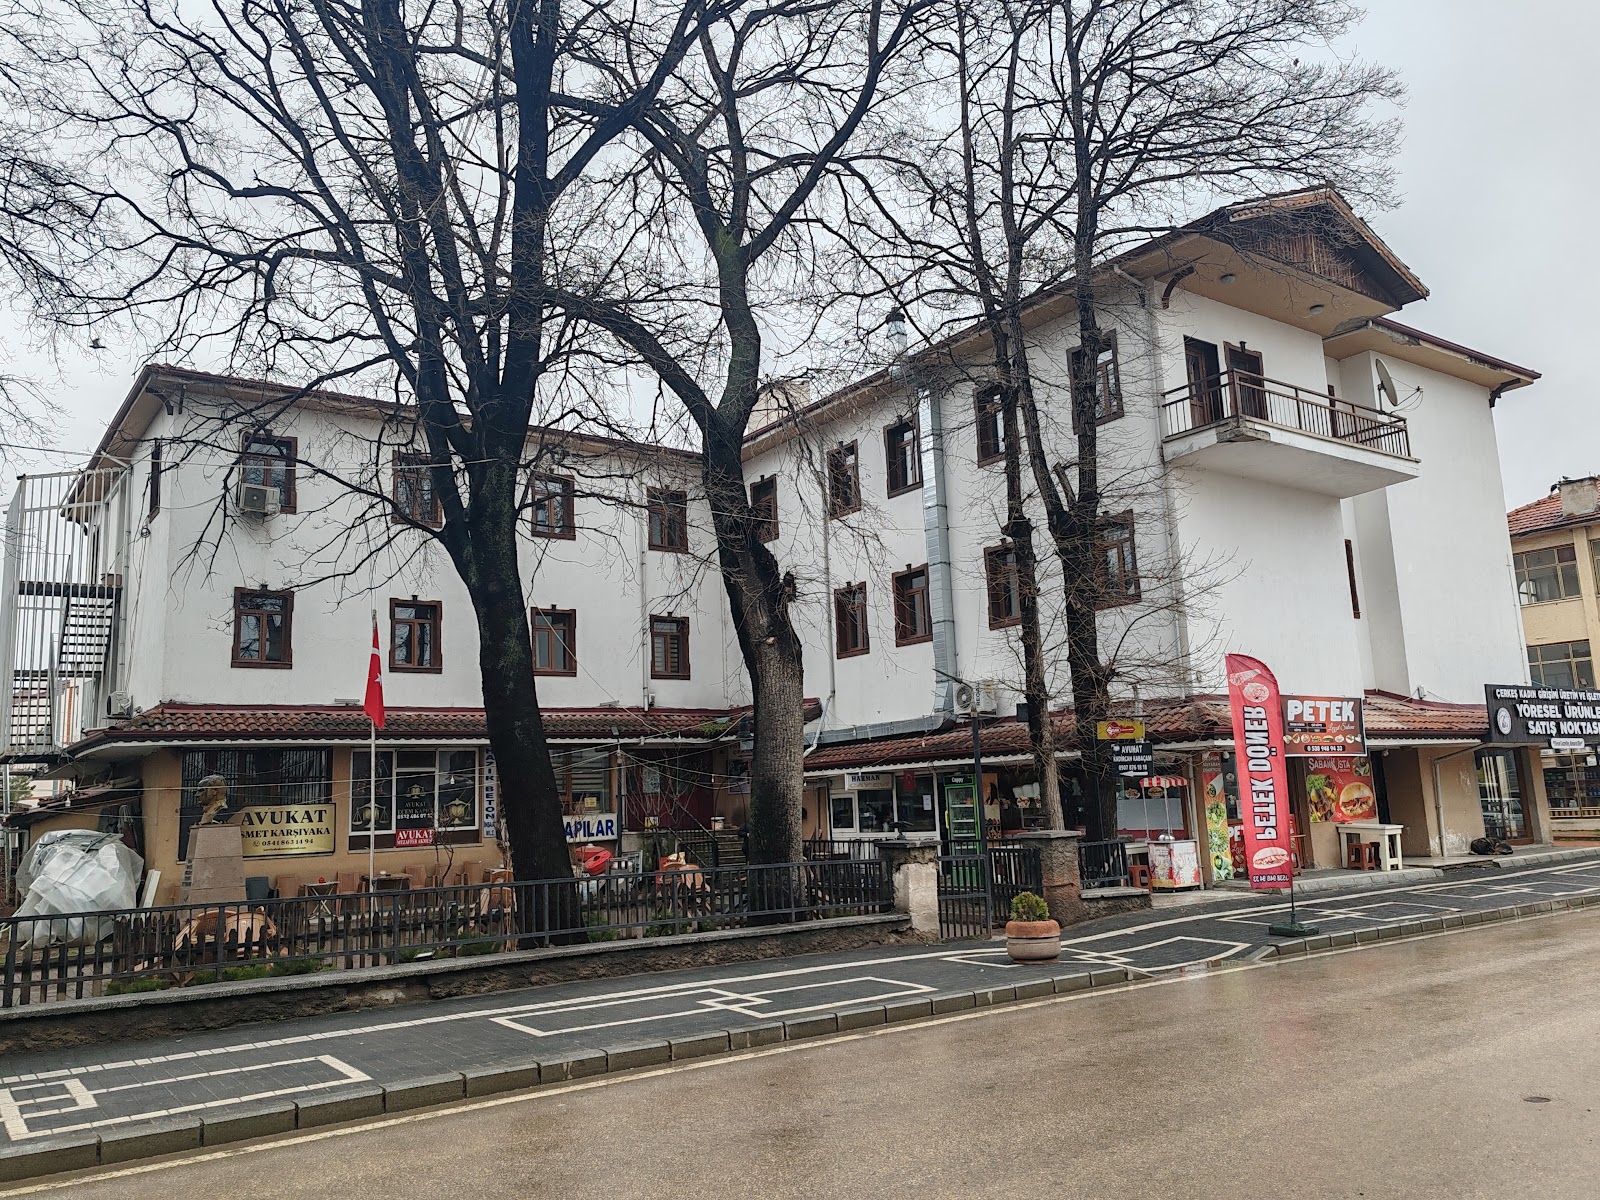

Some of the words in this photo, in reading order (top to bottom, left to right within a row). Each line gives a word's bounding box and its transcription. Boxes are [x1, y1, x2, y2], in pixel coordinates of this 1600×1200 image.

[1495, 689, 1518, 699] ÇERKEŞ
[1519, 690, 1537, 699] KADIN
[1560, 689, 1578, 700] ÜRETİM
[1579, 692, 1586, 700] VE
[1287, 700, 1355, 721] PETEK
[1516, 700, 1562, 718] YÖRESEL
[1528, 721, 1557, 736] SATIŞ
[1121, 745, 1143, 754] AVUKAT
[485, 786, 495, 820] BETON
[242, 809, 327, 826] AVUKAT
[240, 830, 269, 839] SMET
[270, 827, 331, 838] KARŞIYAKA
[397, 829, 434, 840] AVUKAT
[563, 819, 615, 838] APILAR
